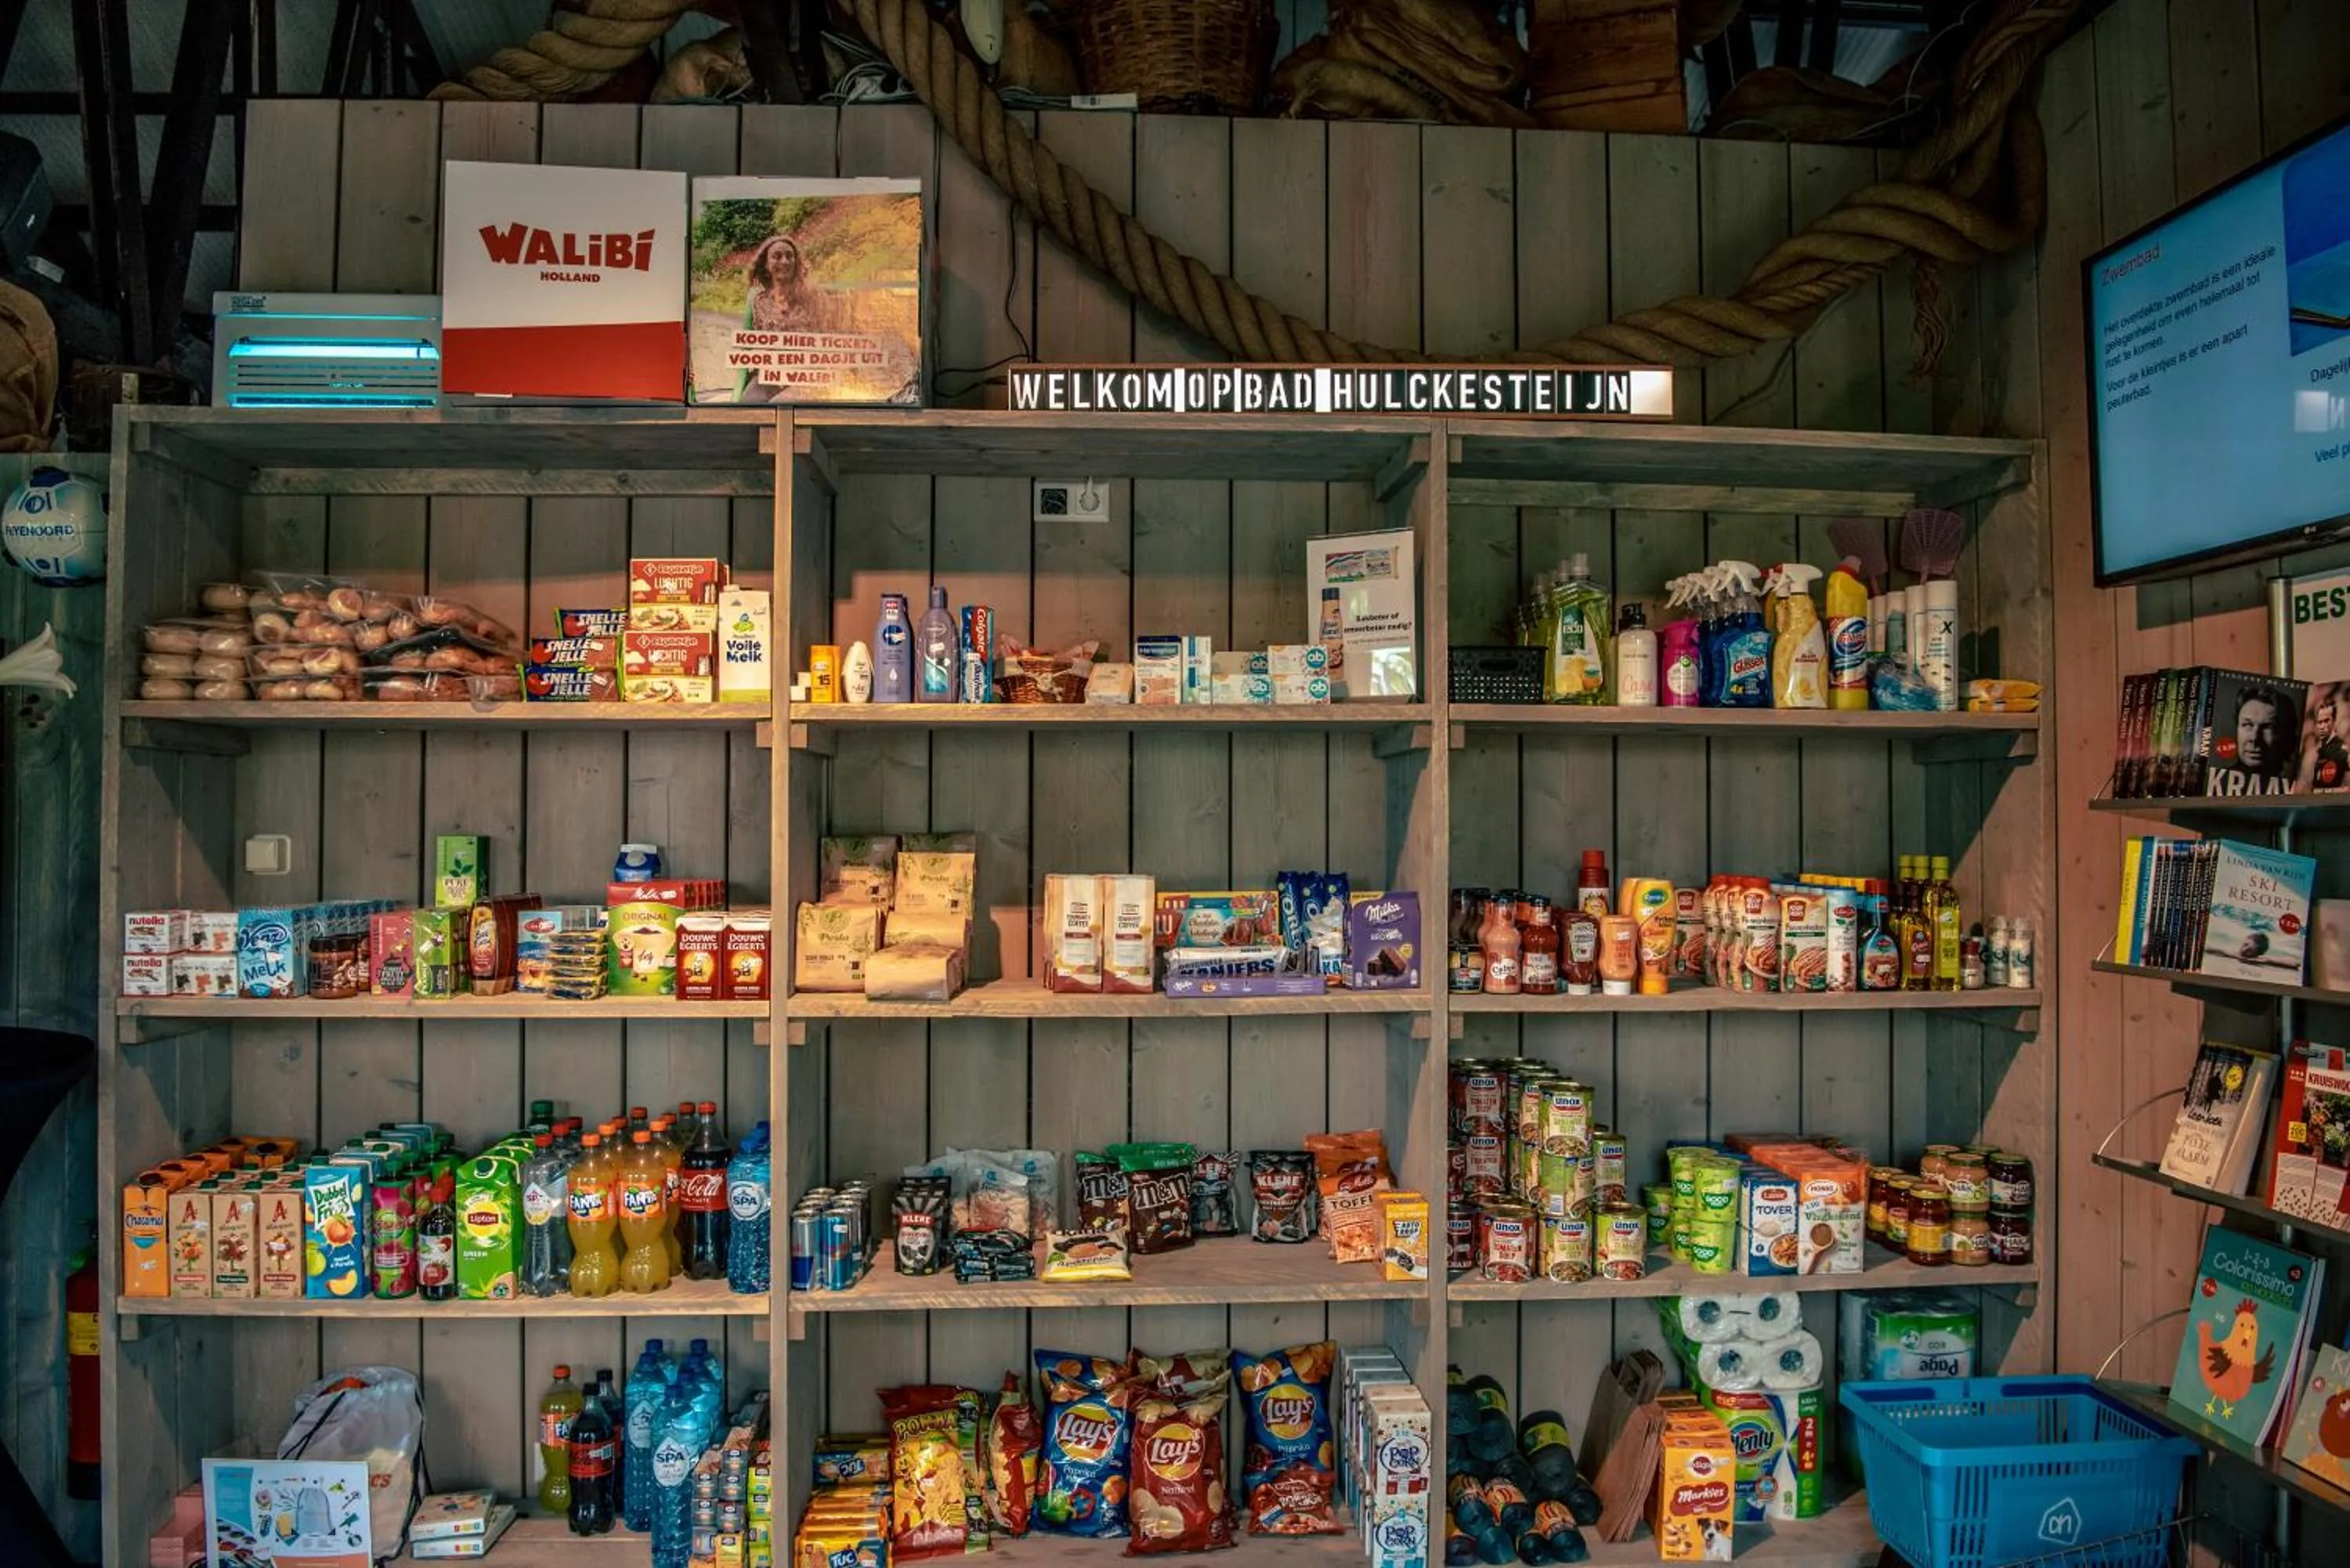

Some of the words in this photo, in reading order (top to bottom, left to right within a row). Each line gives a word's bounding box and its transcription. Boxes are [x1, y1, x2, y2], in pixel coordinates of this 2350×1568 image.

[540, 272, 601, 283] HOLLAND
[2164, 280, 2210, 307] zwembad
[2223, 263, 2242, 277] een
[736, 333, 779, 345] KOOP
[729, 353, 772, 366] VOOR
[778, 352, 804, 364] EEN
[809, 352, 856, 365] DAGJE
[1013, 373, 1172, 410] WELKOM
[1189, 373, 1231, 410] OP
[1246, 374, 1312, 409] BAD
[1334, 374, 1629, 410] HULCKESTEIJN
[2314, 448, 2339, 464] Veel
[2294, 586, 2350, 624] BES
[578, 612, 626, 625] SNELLE
[973, 608, 986, 654] Colgate
[544, 638, 593, 652] SNELLE
[551, 652, 589, 663] JELLE
[725, 652, 763, 663] Melk
[541, 672, 594, 685] SNELLE
[818, 674, 830, 685] 15
[550, 683, 591, 695] JELLE
[2249, 875, 2278, 893] SKI
[2228, 886, 2294, 910] RESORT
[1366, 901, 1402, 922] Milka
[129, 916, 164, 925] nutella
[127, 958, 162, 967] nutella
[1256, 1176, 1297, 1187] KLENE
[313, 1182, 347, 1204] Dubbel
[733, 1195, 758, 1205] SPA
[569, 1193, 602, 1212] FANTA
[624, 1191, 658, 1212] FANTA
[471, 1212, 497, 1225] Lipton
[902, 1214, 931, 1223] KLENE
[1756, 1205, 1792, 1216] TOVER
[2213, 1252, 2295, 1296] Colorissimo
[1919, 1357, 1959, 1377] Page
[1266, 1397, 1314, 1425] Lay's
[1060, 1413, 1115, 1448] Lay's
[1151, 1429, 1202, 1466] Lay's
[1389, 1446, 1419, 1463] POP
[656, 1452, 686, 1464] SPA
[1678, 1487, 1725, 1504] Markies
[1384, 1523, 1416, 1541] POP
[1384, 1536, 1417, 1549] CORN
[830, 1551, 856, 1567] TUC
